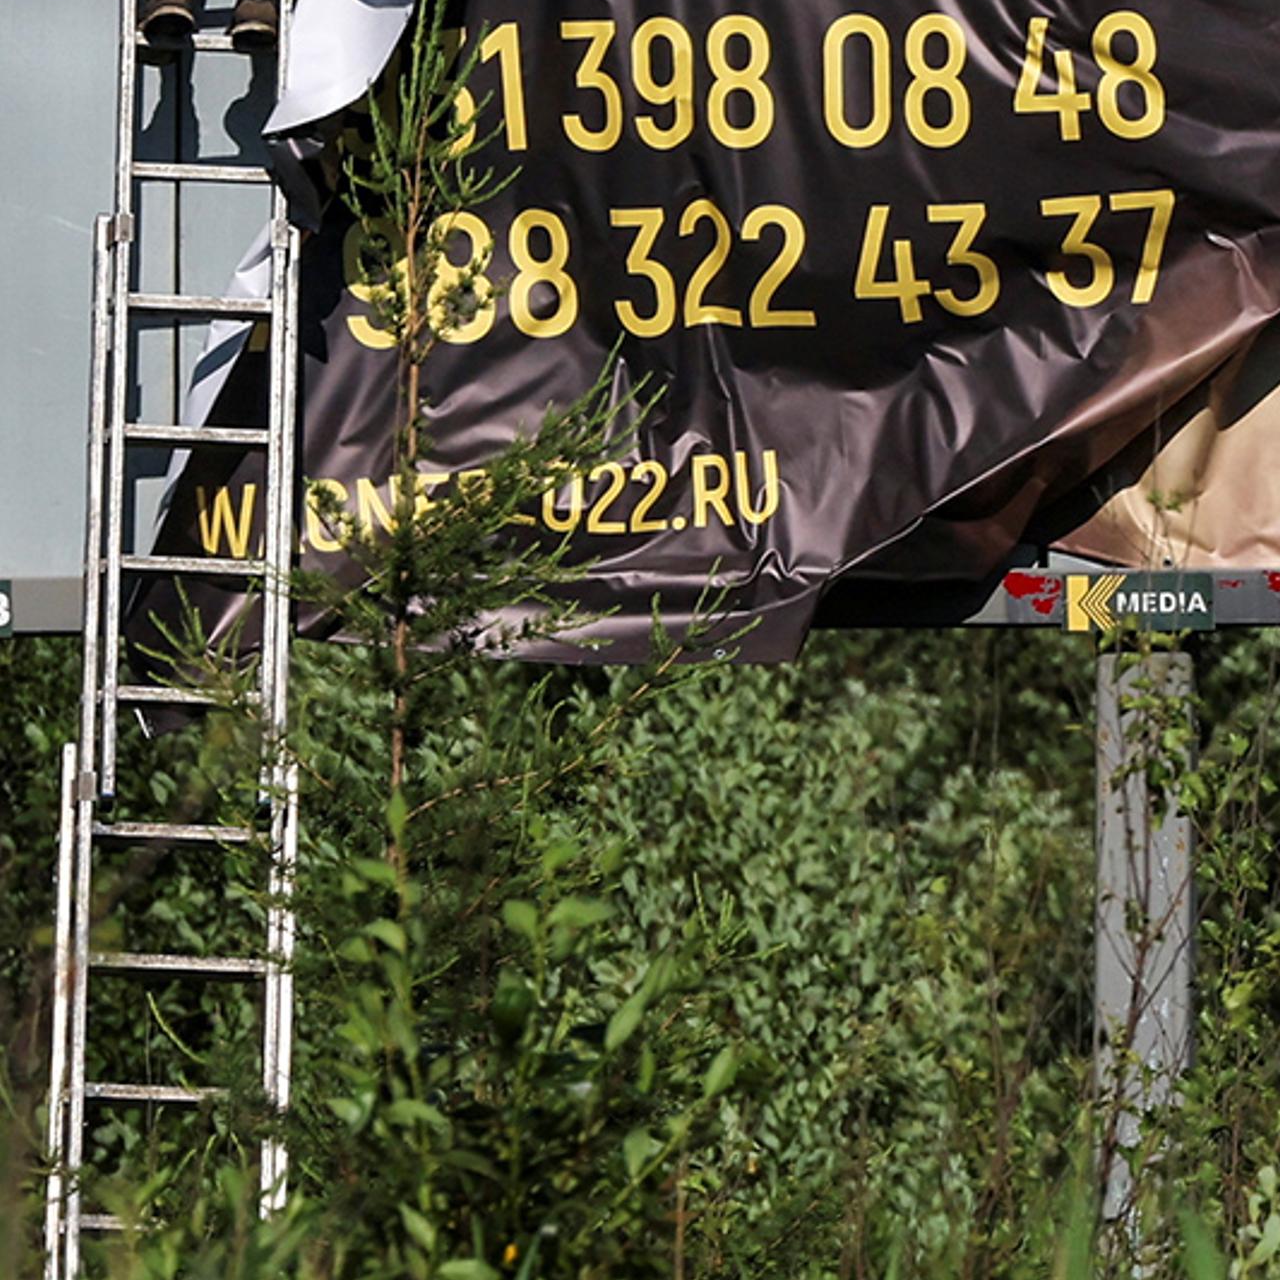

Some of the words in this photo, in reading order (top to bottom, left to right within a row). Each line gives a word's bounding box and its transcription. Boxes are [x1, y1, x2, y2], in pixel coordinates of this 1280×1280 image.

[560, 13, 775, 152] 398
[822, 12, 972, 149] 08
[1013, 9, 1166, 142] 48
[609, 198, 817, 338] 322
[854, 202, 1000, 325] 43
[1039, 188, 1176, 308] 37
